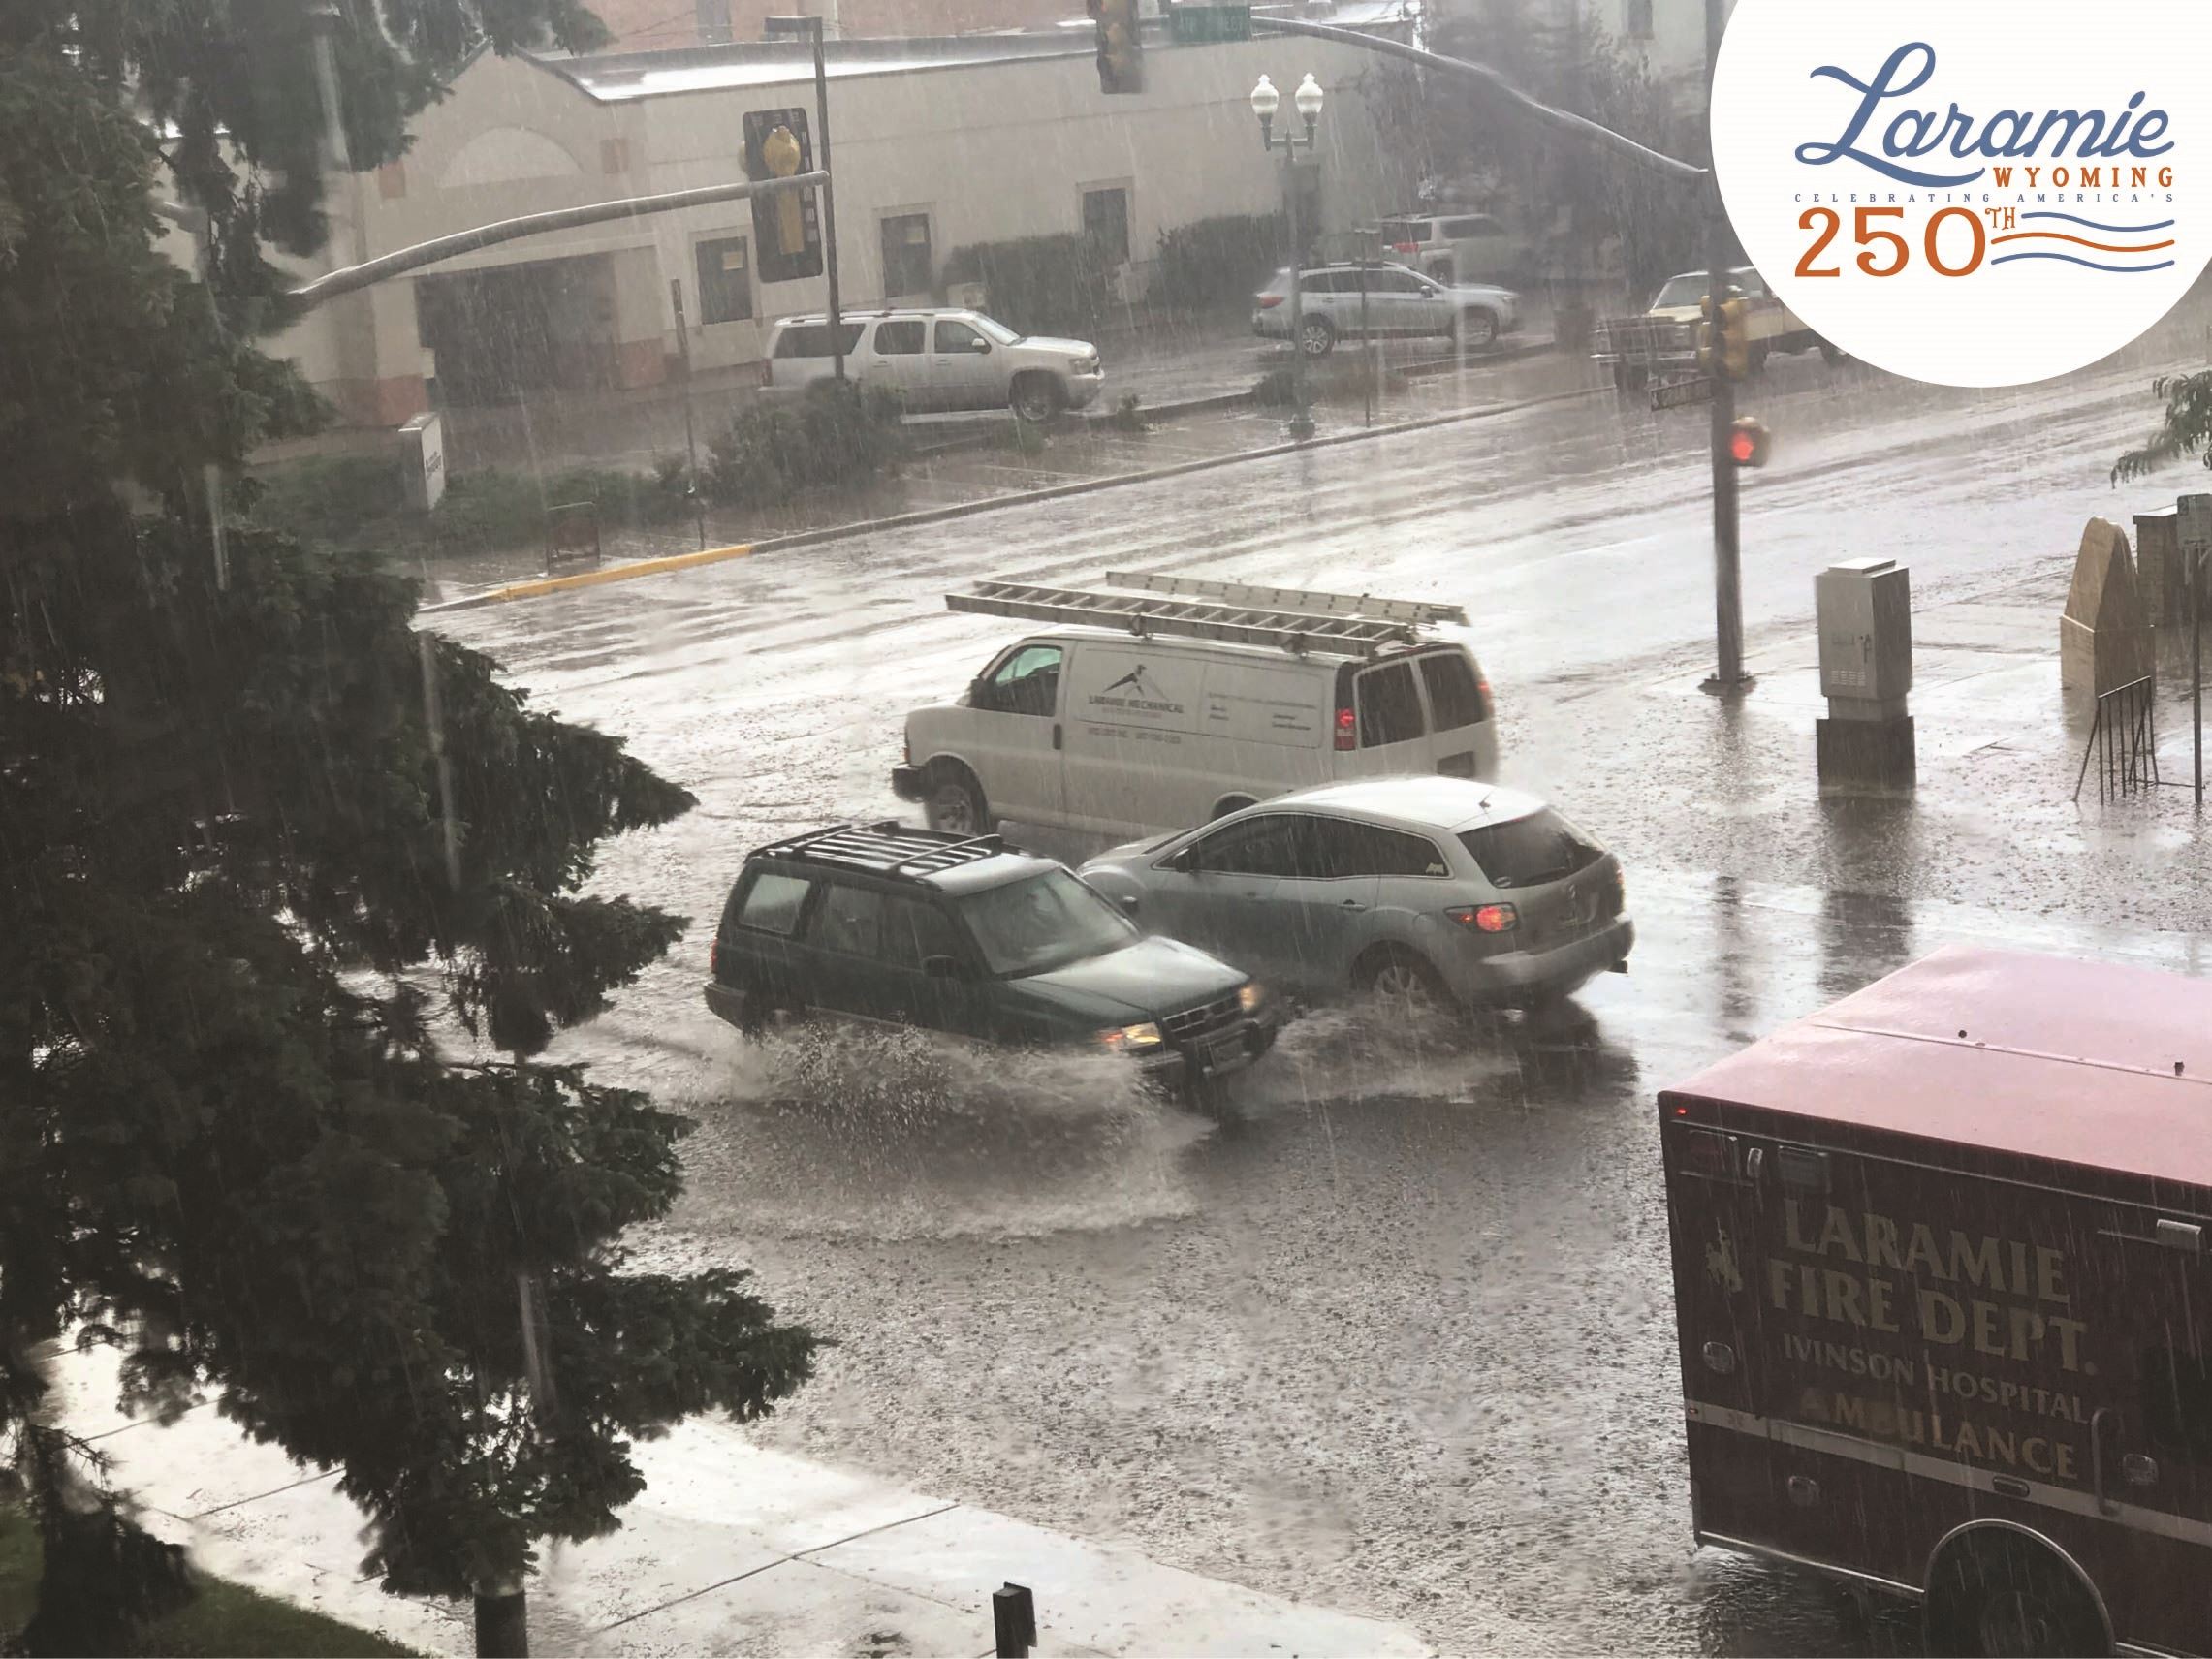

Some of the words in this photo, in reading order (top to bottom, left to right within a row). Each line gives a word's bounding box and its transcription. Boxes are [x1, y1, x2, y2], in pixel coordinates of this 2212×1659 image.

[1782, 1198, 2070, 1304] LARAMIE
[1768, 1258, 1901, 1333] FIRE
[1922, 1290, 2099, 1376] DEPT.
[1784, 1333, 1915, 1386] IVINSON
[1928, 1362, 2091, 1425] HOSPITAL
